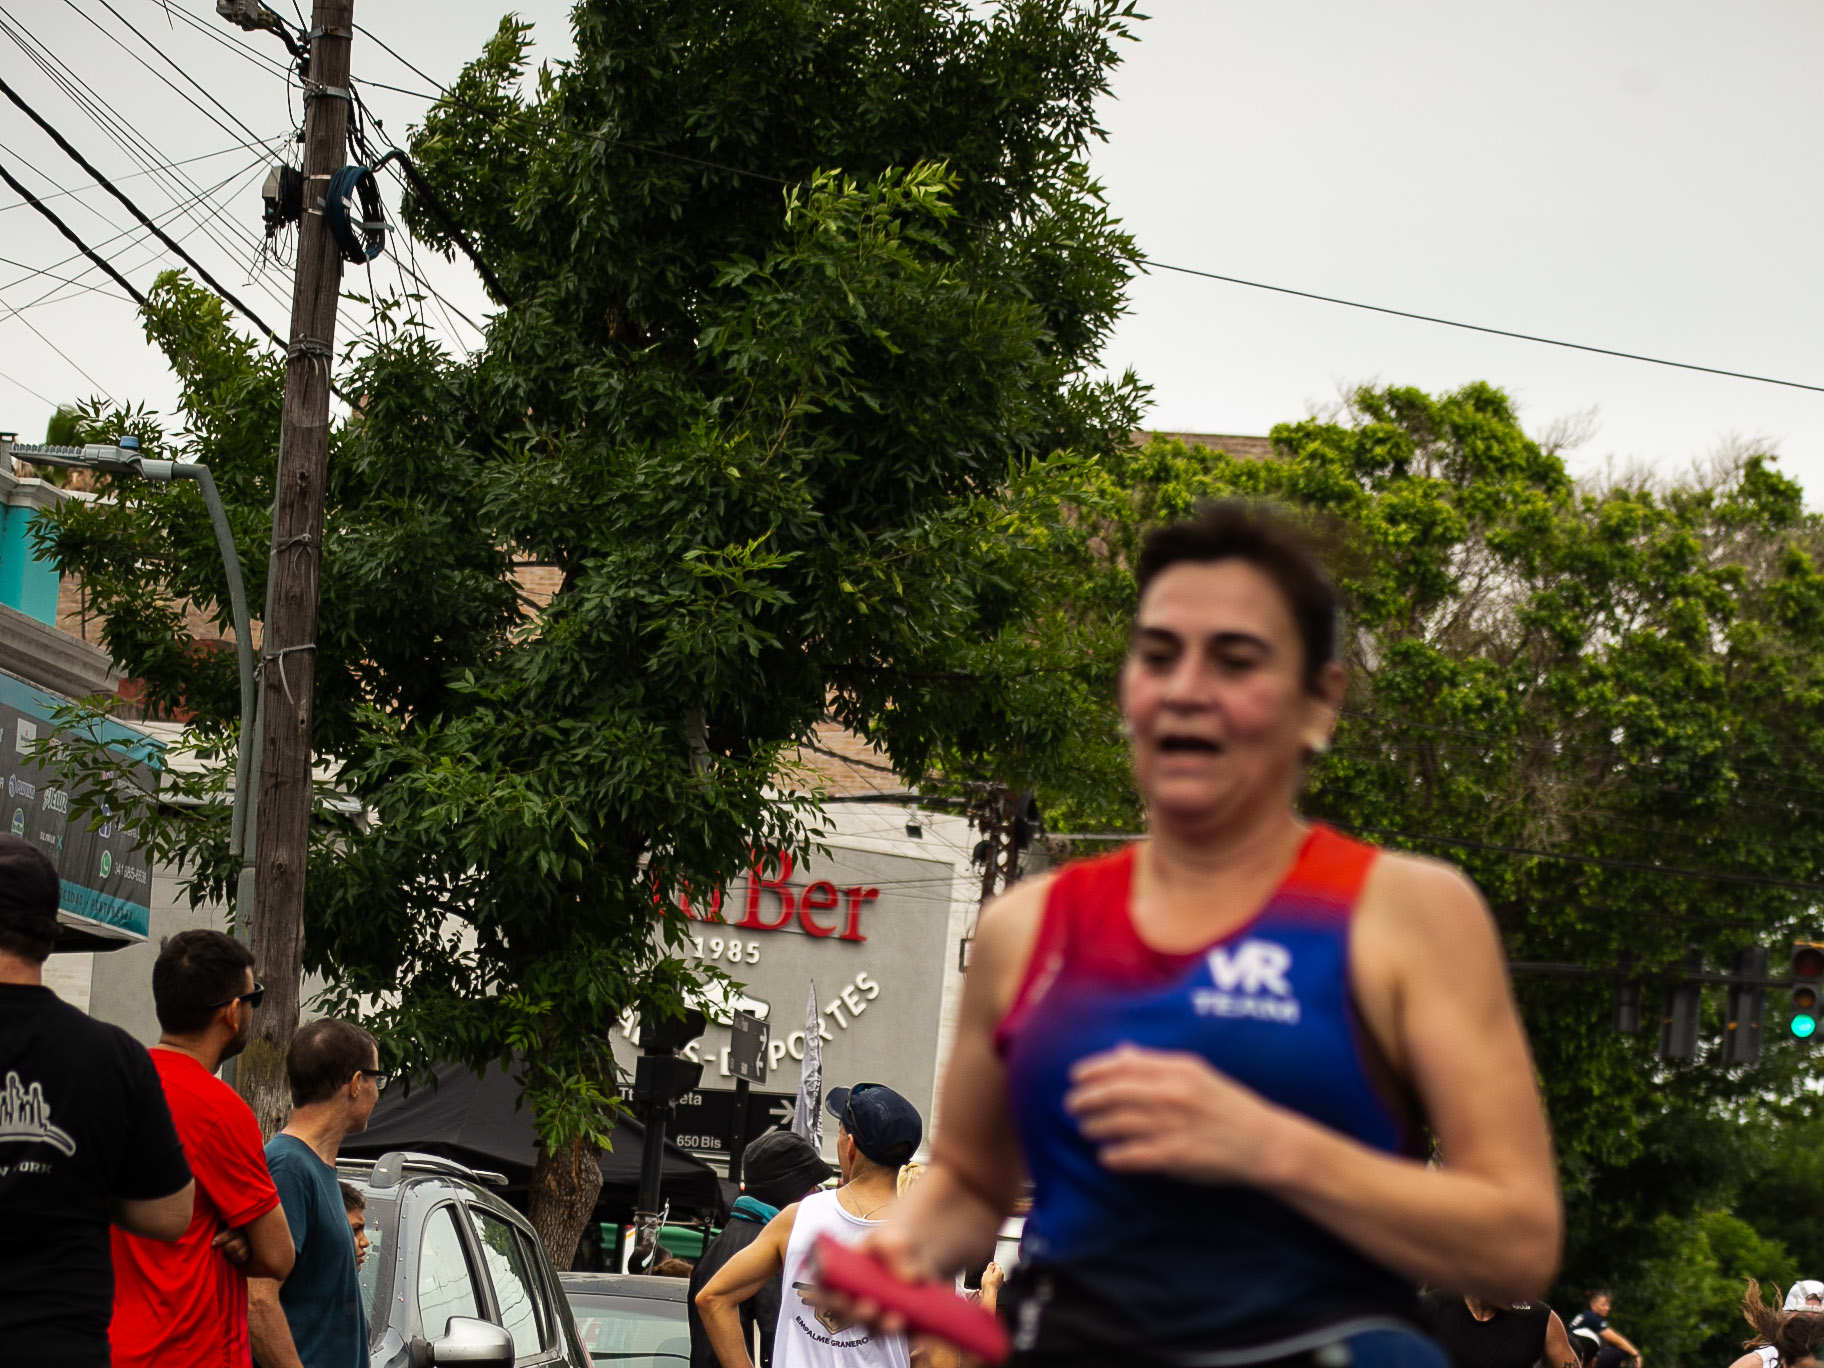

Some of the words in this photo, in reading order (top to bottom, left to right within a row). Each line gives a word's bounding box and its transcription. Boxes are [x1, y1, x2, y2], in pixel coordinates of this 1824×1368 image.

[736, 843, 880, 942] Ber
[691, 936, 760, 965] 1985
[1206, 937, 1293, 996] VR
[676, 1135, 700, 1148] 650
[701, 1136, 722, 1149] Bis
[795, 1315, 830, 1345] EMPALME
